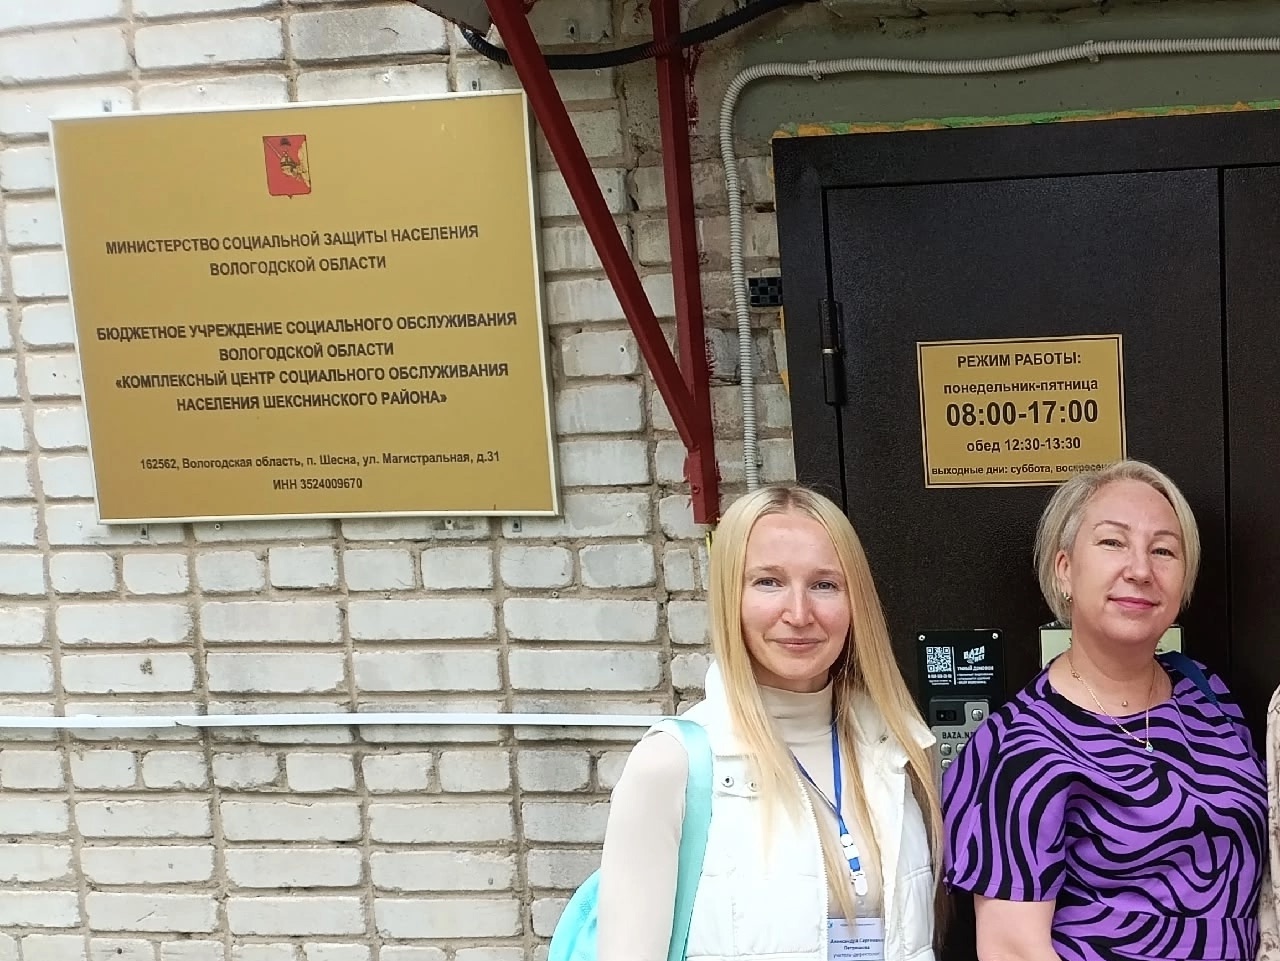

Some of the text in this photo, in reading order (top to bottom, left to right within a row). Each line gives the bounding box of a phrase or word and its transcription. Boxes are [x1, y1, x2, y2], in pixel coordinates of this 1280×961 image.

[105, 224, 479, 255] МИНИСТЕРСТВО СОЦИАЛЬНОЙ ЗАЩИТЫ НАСЕЛЕНИЯ
[209, 255, 386, 277] ВОЛОГОДСКОЙ ОБЛАСТИ
[96, 311, 518, 342] БЮДЖЕТНОЕ УЧРЕЖДЕНИЕ СОЦИАЛЬНОГО ОБСЛУЖИВАНИЯ
[219, 342, 394, 361] ВОЛОГОДСКОЙ ОБЛАСТИ
[957, 351, 1082, 368] РЕЖИМ РАБОТЫ:
[115, 362, 509, 389] «КОМПЛЕКСНЫЙ ЦЕНТР СОЦИАЛЬНОГО ОБСЛУЖИВАНИЯ
[943, 379, 1098, 394] понедельник-пятница
[176, 388, 448, 411] НАСЕЛЕНИЯ ШЕКСНИНСКОГО РАЙОНА»
[945, 398, 1098, 427] 08:00-17:00
[966, 436, 1081, 452] обед 12:30-13:30
[140, 451, 500, 471] 162562, Вологодская область, п. Шесна, ул. Магистральная, д.31
[931, 466, 984, 476] выходные
[985, 465, 1008, 475] дни:
[1010, 463, 1053, 474] суббота,
[272, 477, 363, 490] ИНН 3524009670
